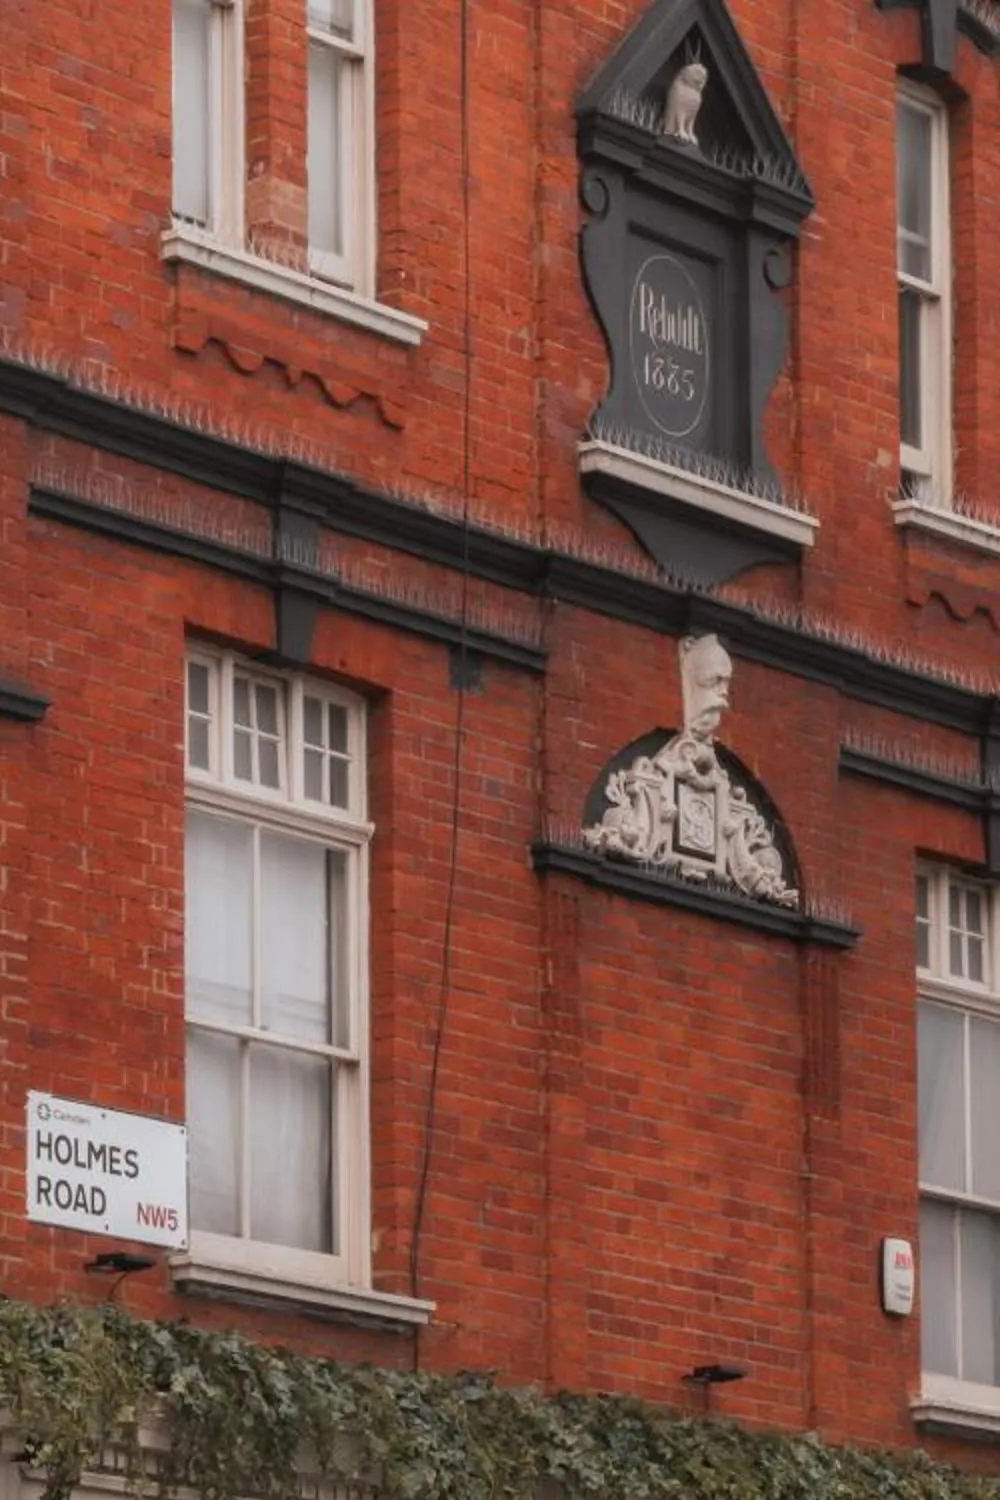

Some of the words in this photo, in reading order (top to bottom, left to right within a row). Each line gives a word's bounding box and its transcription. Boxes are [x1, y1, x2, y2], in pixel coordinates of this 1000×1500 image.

[36, 1130, 139, 1179] HOLMES
[36, 1175, 107, 1216] ROAD
[137, 1202, 179, 1232] NW5
